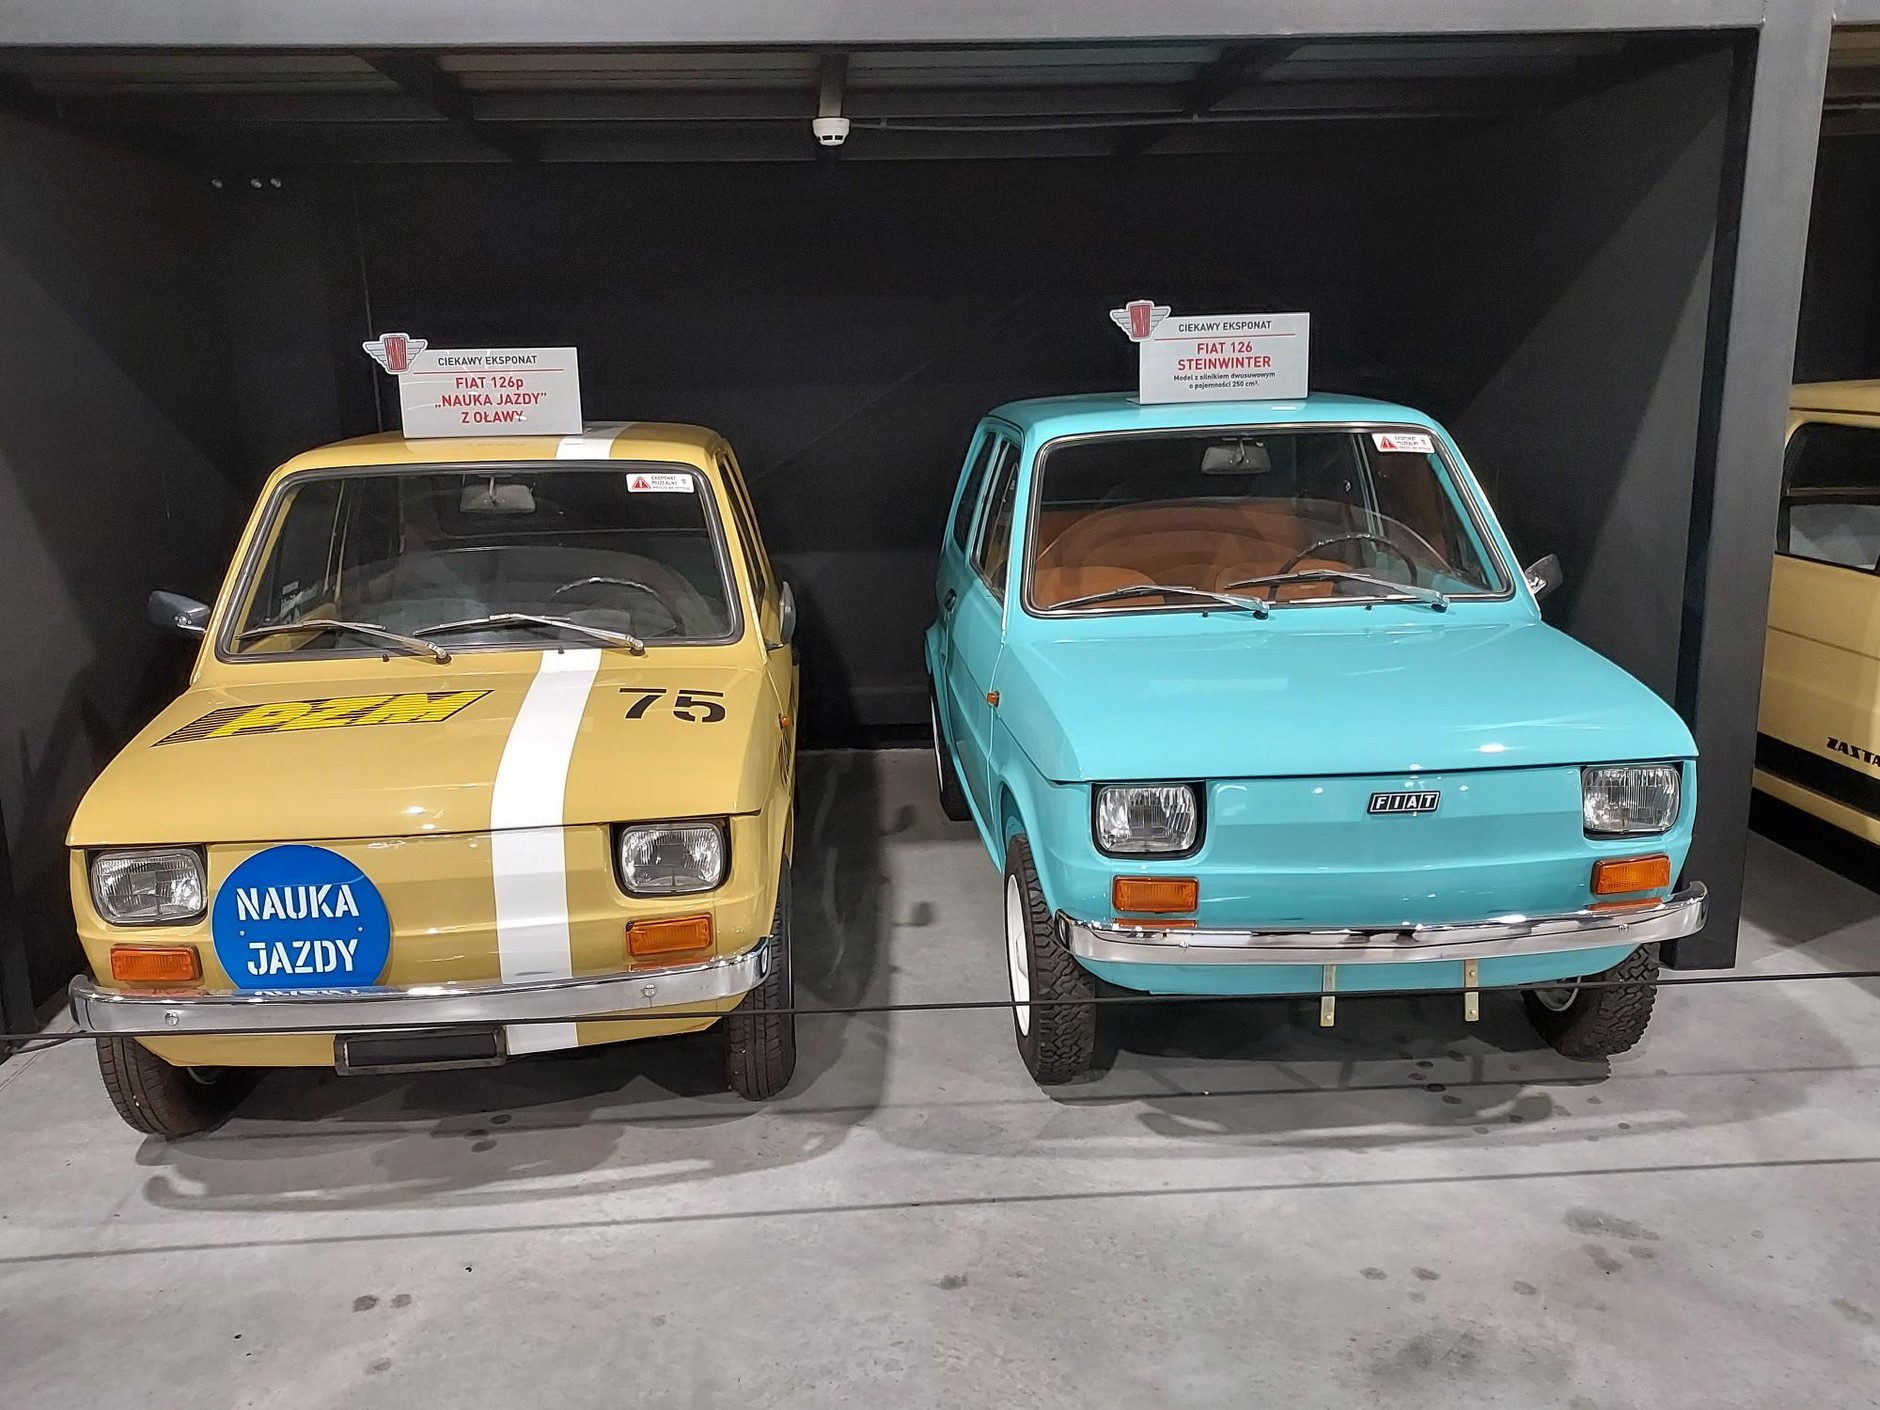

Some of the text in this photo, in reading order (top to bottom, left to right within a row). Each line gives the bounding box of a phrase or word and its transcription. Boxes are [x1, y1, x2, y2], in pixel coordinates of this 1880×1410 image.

[1178, 321, 1272, 332] CIEKAWY EKSPONAT
[1197, 341, 1253, 355] FIAT 126
[438, 355, 538, 367] CIEKAWY EKSPONAT
[1178, 356, 1271, 371] STEINWINTER
[455, 376, 524, 391] FIAT 126p
[1194, 381, 1231, 390] pojemności
[461, 410, 524, 424] Z OŁAWY
[619, 688, 726, 722] 75
[206, 691, 488, 738] PZM
[1374, 794, 1436, 810] FIAT
[236, 884, 360, 921] NAUKA
[246, 938, 359, 976] JAZDY
